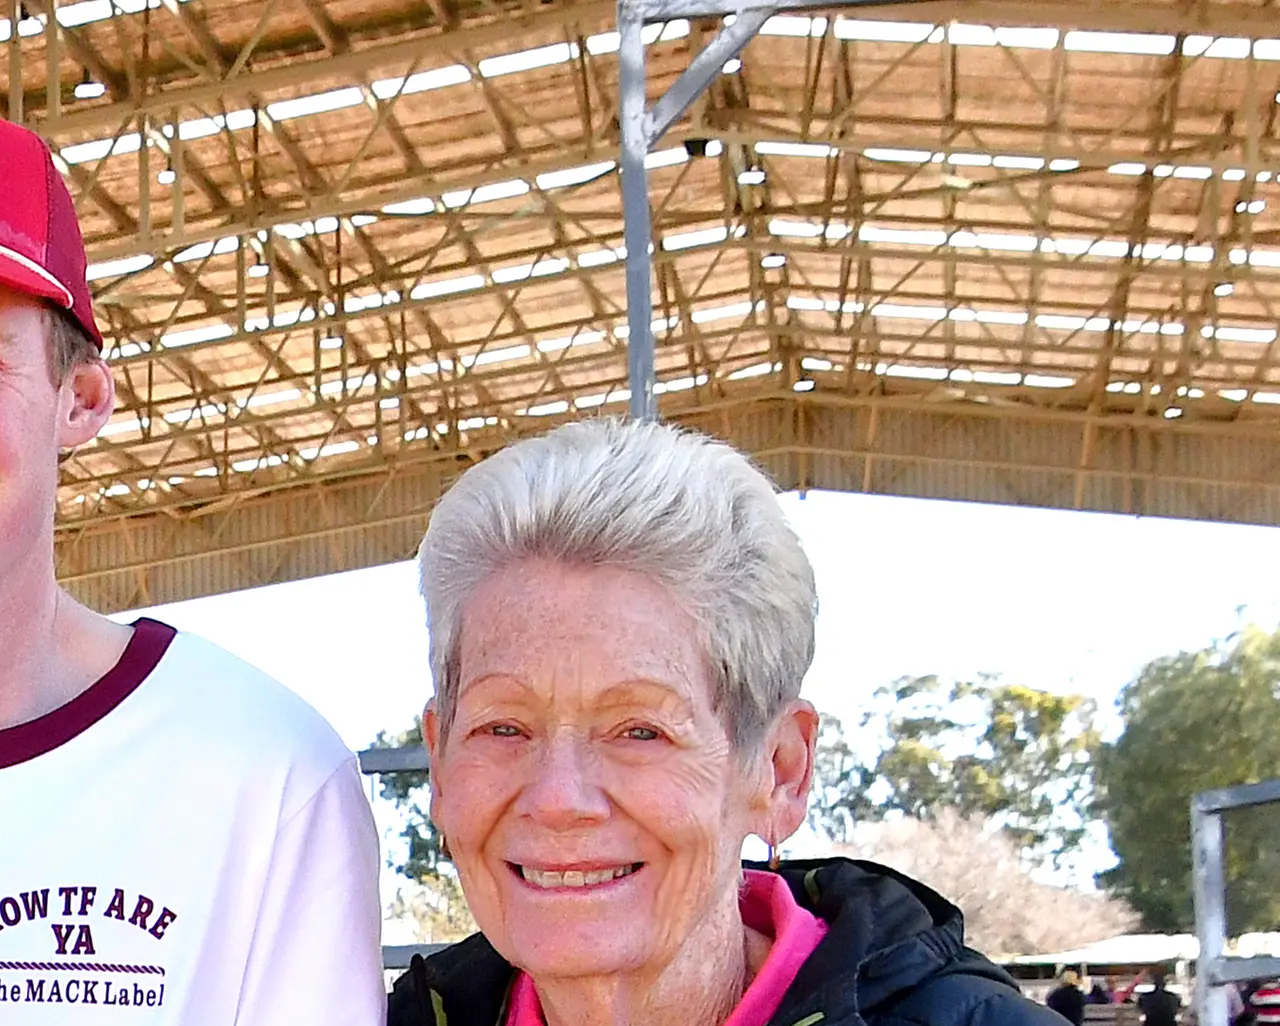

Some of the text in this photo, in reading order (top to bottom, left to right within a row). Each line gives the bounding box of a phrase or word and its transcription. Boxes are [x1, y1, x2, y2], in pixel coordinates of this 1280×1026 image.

[58, 886, 97, 917] TF
[103, 888, 178, 940] ARE
[51, 924, 96, 955] YA
[24, 979, 99, 1004] MACK
[102, 982, 165, 1007] Label
